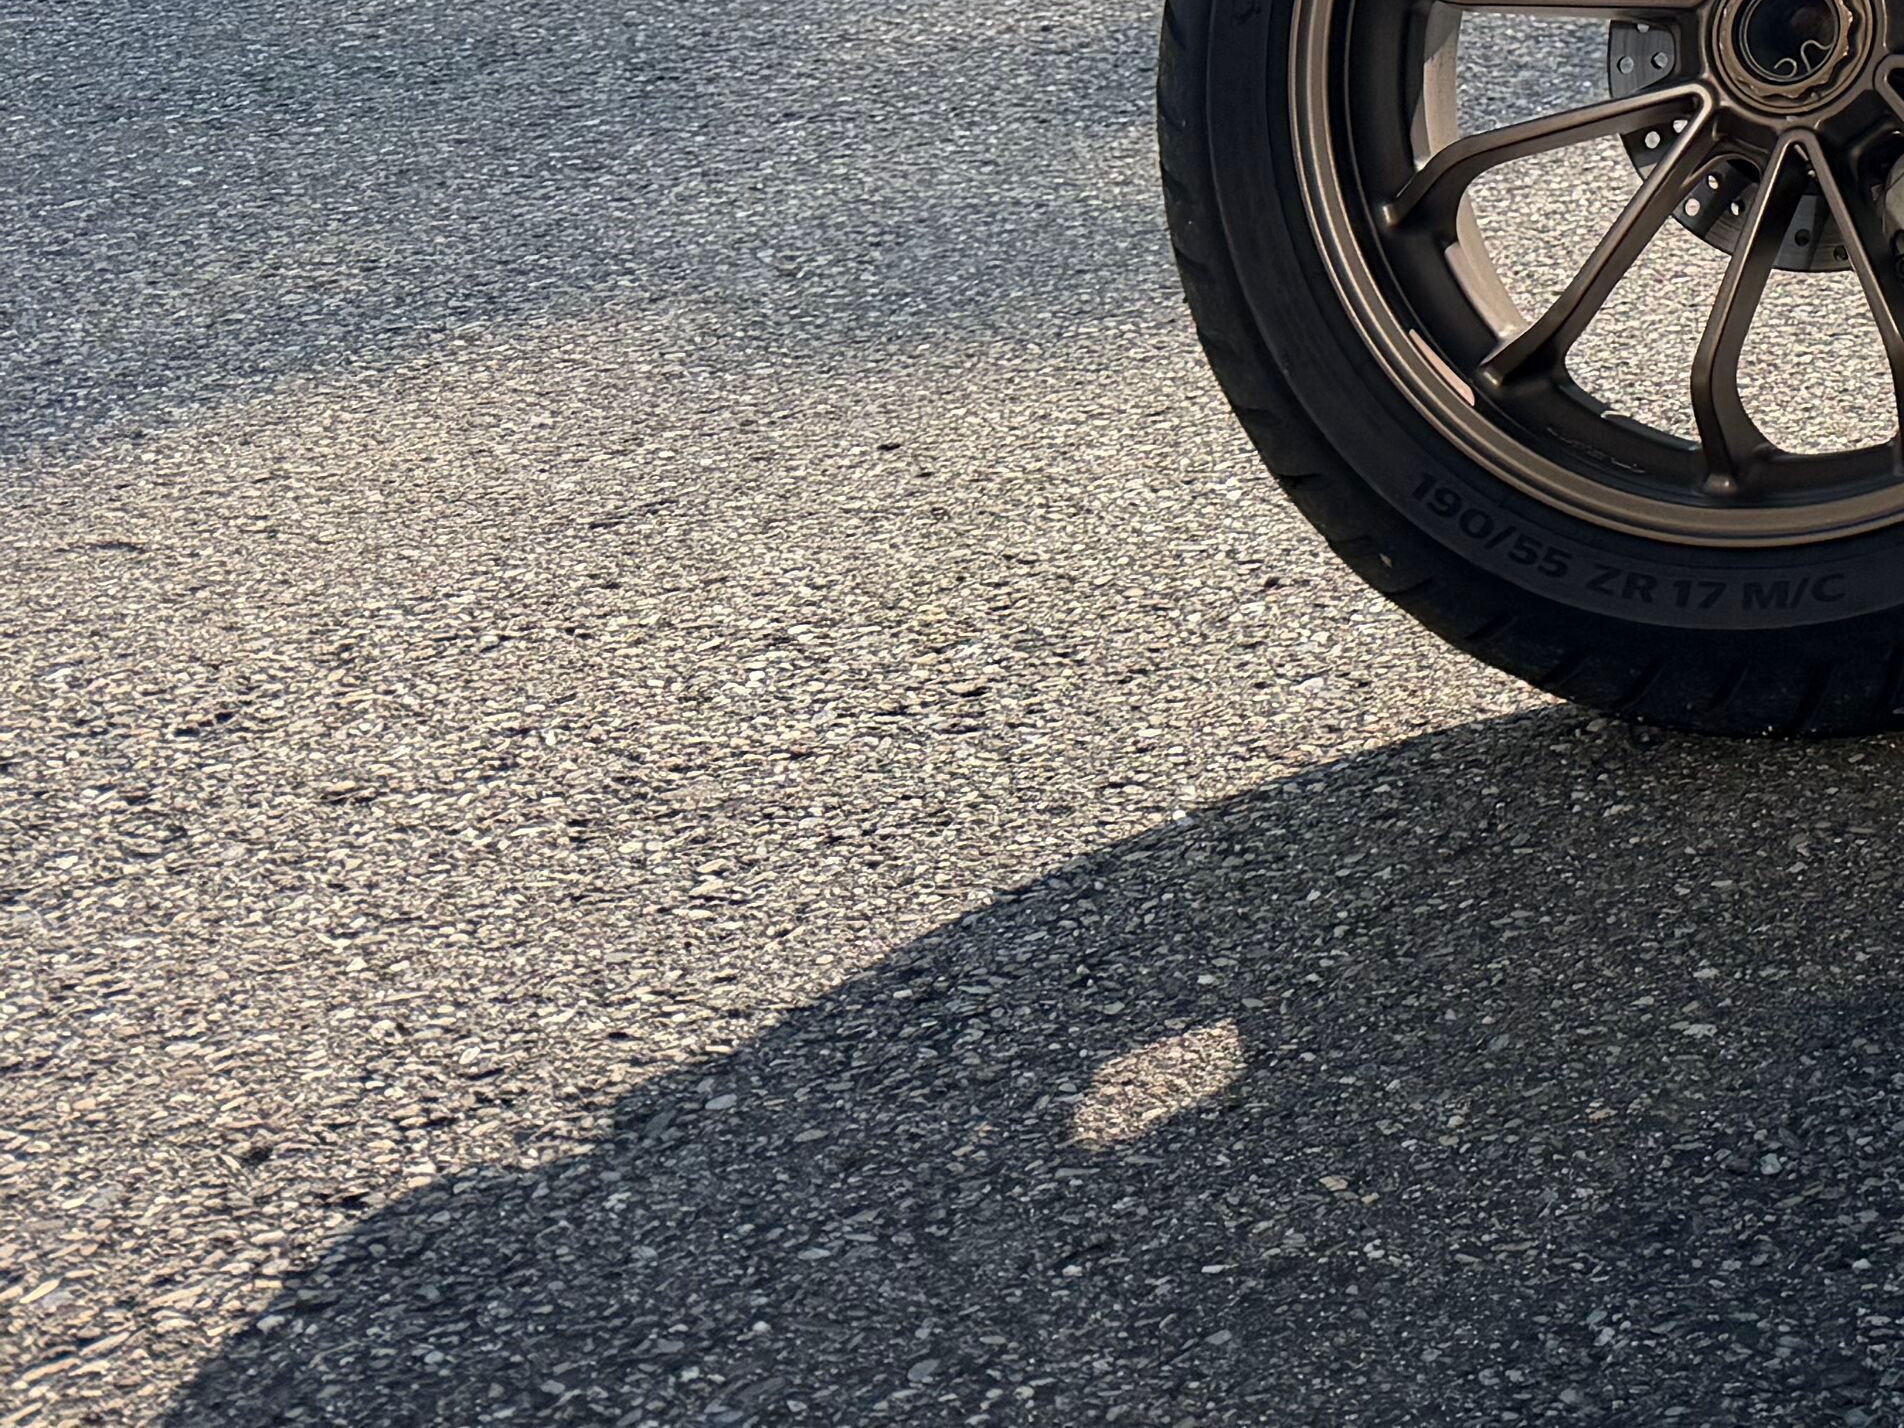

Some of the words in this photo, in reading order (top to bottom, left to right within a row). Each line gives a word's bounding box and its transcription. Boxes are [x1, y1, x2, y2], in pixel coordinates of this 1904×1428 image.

[1410, 471, 1572, 580] 190/55
[1584, 559, 1656, 607] ZR
[1672, 576, 1728, 611] 17
[1740, 570, 1848, 613] M/C
